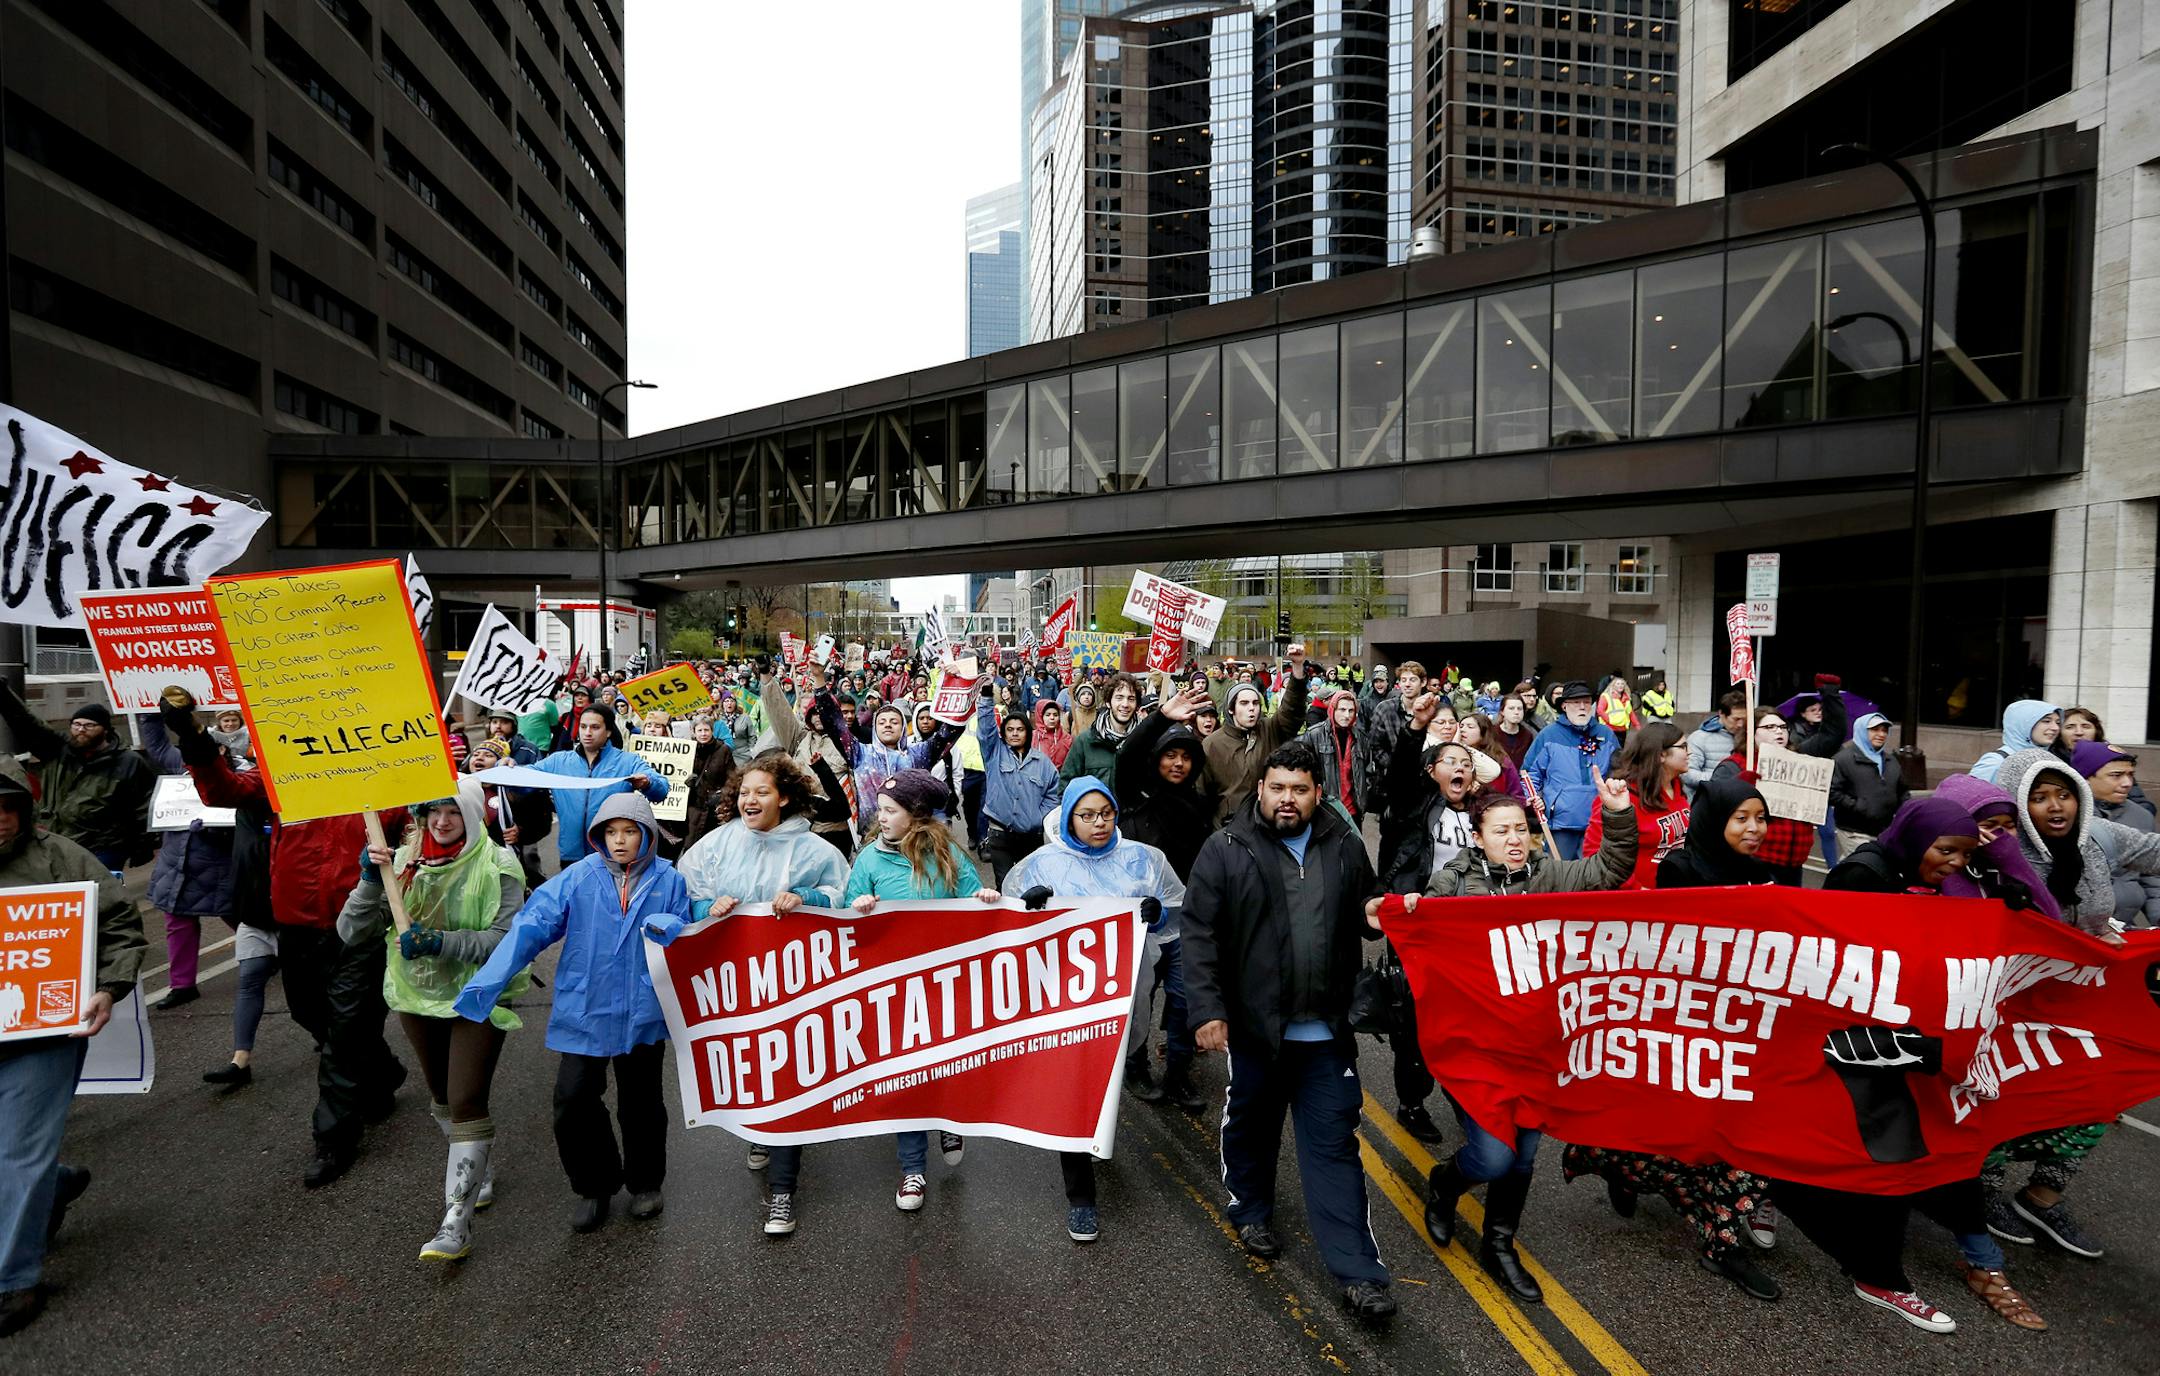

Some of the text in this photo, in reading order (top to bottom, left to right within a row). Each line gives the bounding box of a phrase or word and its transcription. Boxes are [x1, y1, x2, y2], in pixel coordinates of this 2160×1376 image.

[218, 576, 341, 606] Pays Taxes
[84, 600, 208, 621] WE STAND WIT
[233, 593, 387, 627] NO Criminal Record
[1753, 603, 1769, 612] NO
[97, 625, 144, 637] FRANKLIN
[144, 624, 179, 635] STREET
[240, 622, 360, 651] US Citizen Wife
[111, 638, 216, 660] WORKERS
[247, 645, 382, 673] US Citizen Children
[1082, 653, 1116, 667] DAY
[354, 662, 396, 673] Mexico
[261, 686, 362, 708] Speaks English
[632, 678, 688, 707] 1965
[634, 740, 691, 755] DEMAND
[306, 770, 321, 780] no
[322, 765, 379, 784] pathway
[376, 758, 390, 769] to
[392, 753, 437, 768] change
[651, 762, 675, 776] ND
[1759, 758, 1827, 788] EVERYONE
[6, 901, 83, 922] WITH
[4, 928, 70, 942] BAKERY
[690, 925, 861, 1018] NO MORE
[1488, 919, 1912, 1025] INTERNATIONAL
[705, 920, 1120, 1106] DEPORTATIONS!
[1557, 975, 1792, 1041] RESPECT
[832, 1088, 866, 1114] MIRAC
[874, 1070, 929, 1097] MINNESOTA
[930, 1052, 988, 1081] IMMIGRANT
[989, 1040, 1026, 1063] RIGHTS
[1027, 1033, 1059, 1053] ACTION
[1060, 1020, 1119, 1047] COMMITTEE
[1557, 1027, 1758, 1103] JUSTICE
